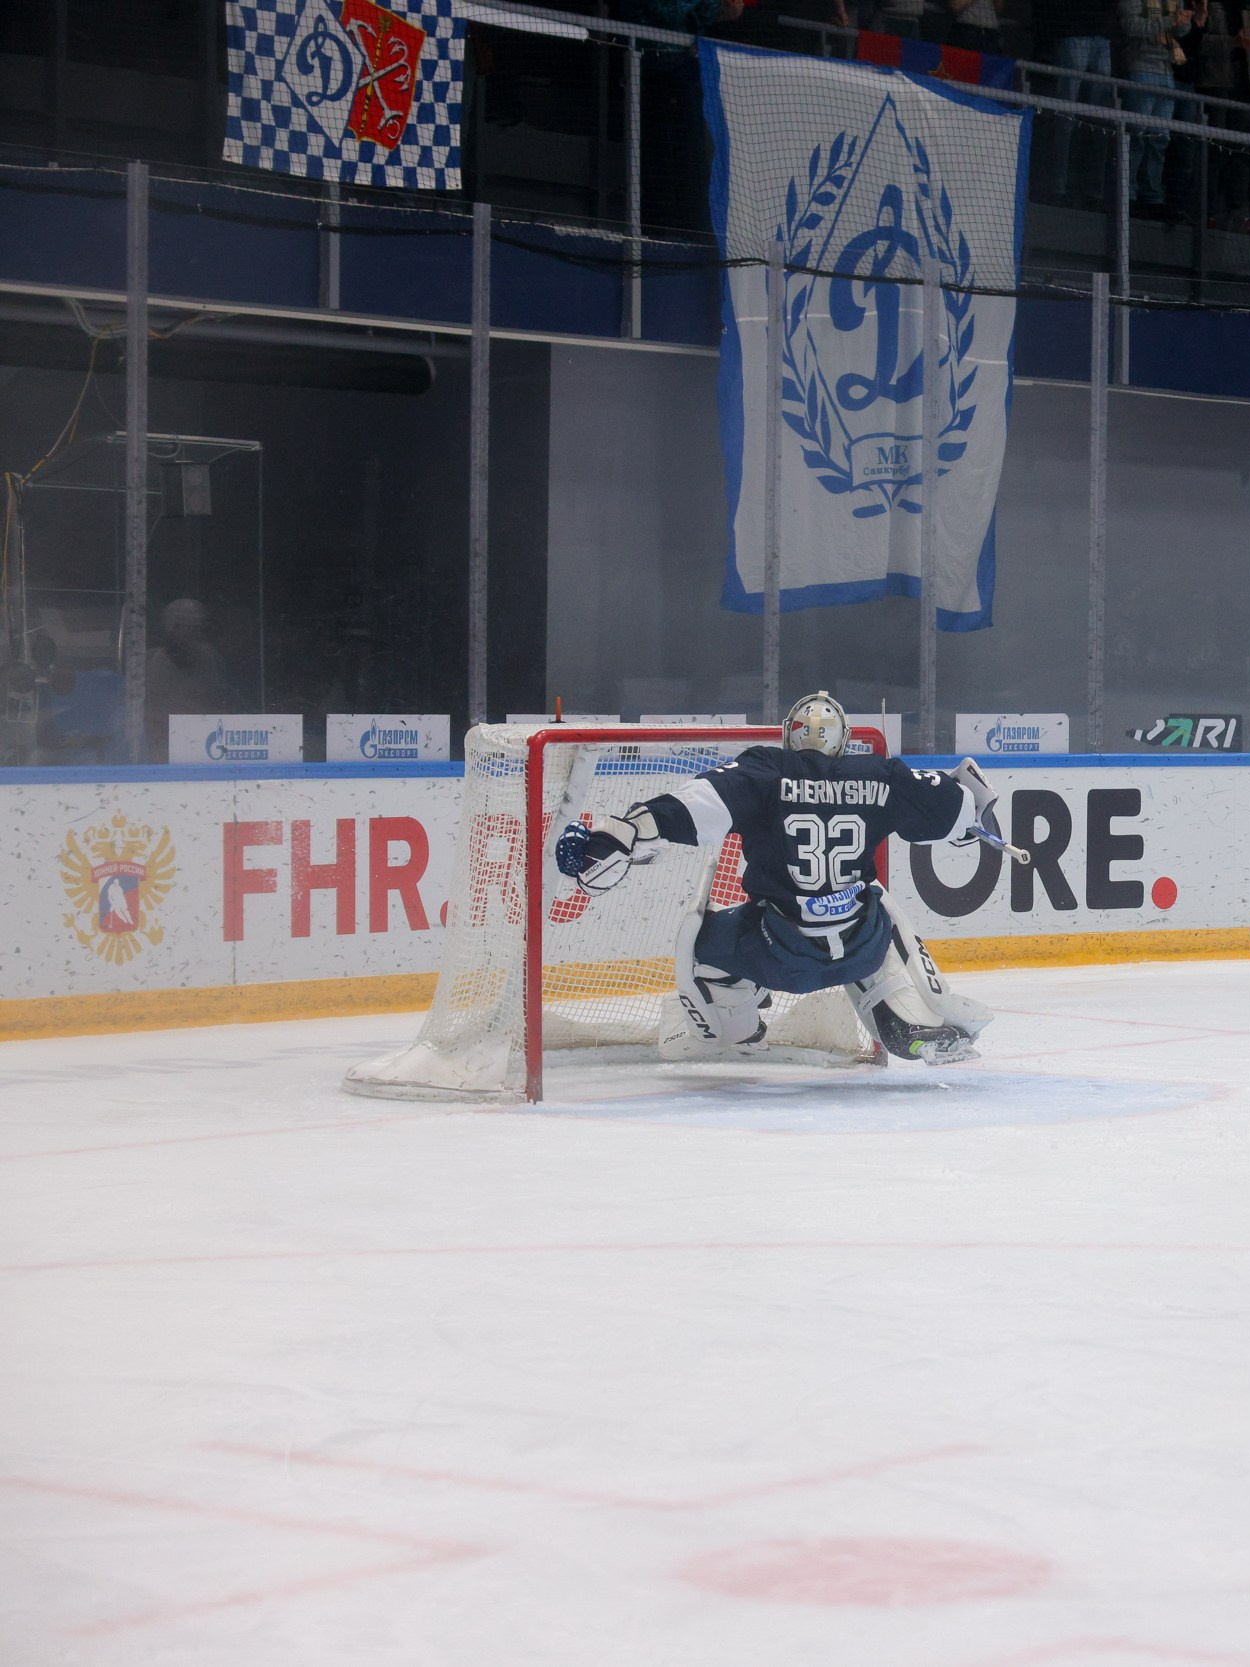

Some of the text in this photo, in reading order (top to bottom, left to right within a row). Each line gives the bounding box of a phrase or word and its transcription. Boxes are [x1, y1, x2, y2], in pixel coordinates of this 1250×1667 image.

[225, 730, 268, 746] ГАЗПРОМ
[378, 729, 418, 745] ГАЗПРОМ
[1003, 726, 1040, 740] ГАЗПРОМ
[783, 814, 866, 891] 32
[914, 935, 943, 995] CCM
[679, 994, 717, 1039] CCM
